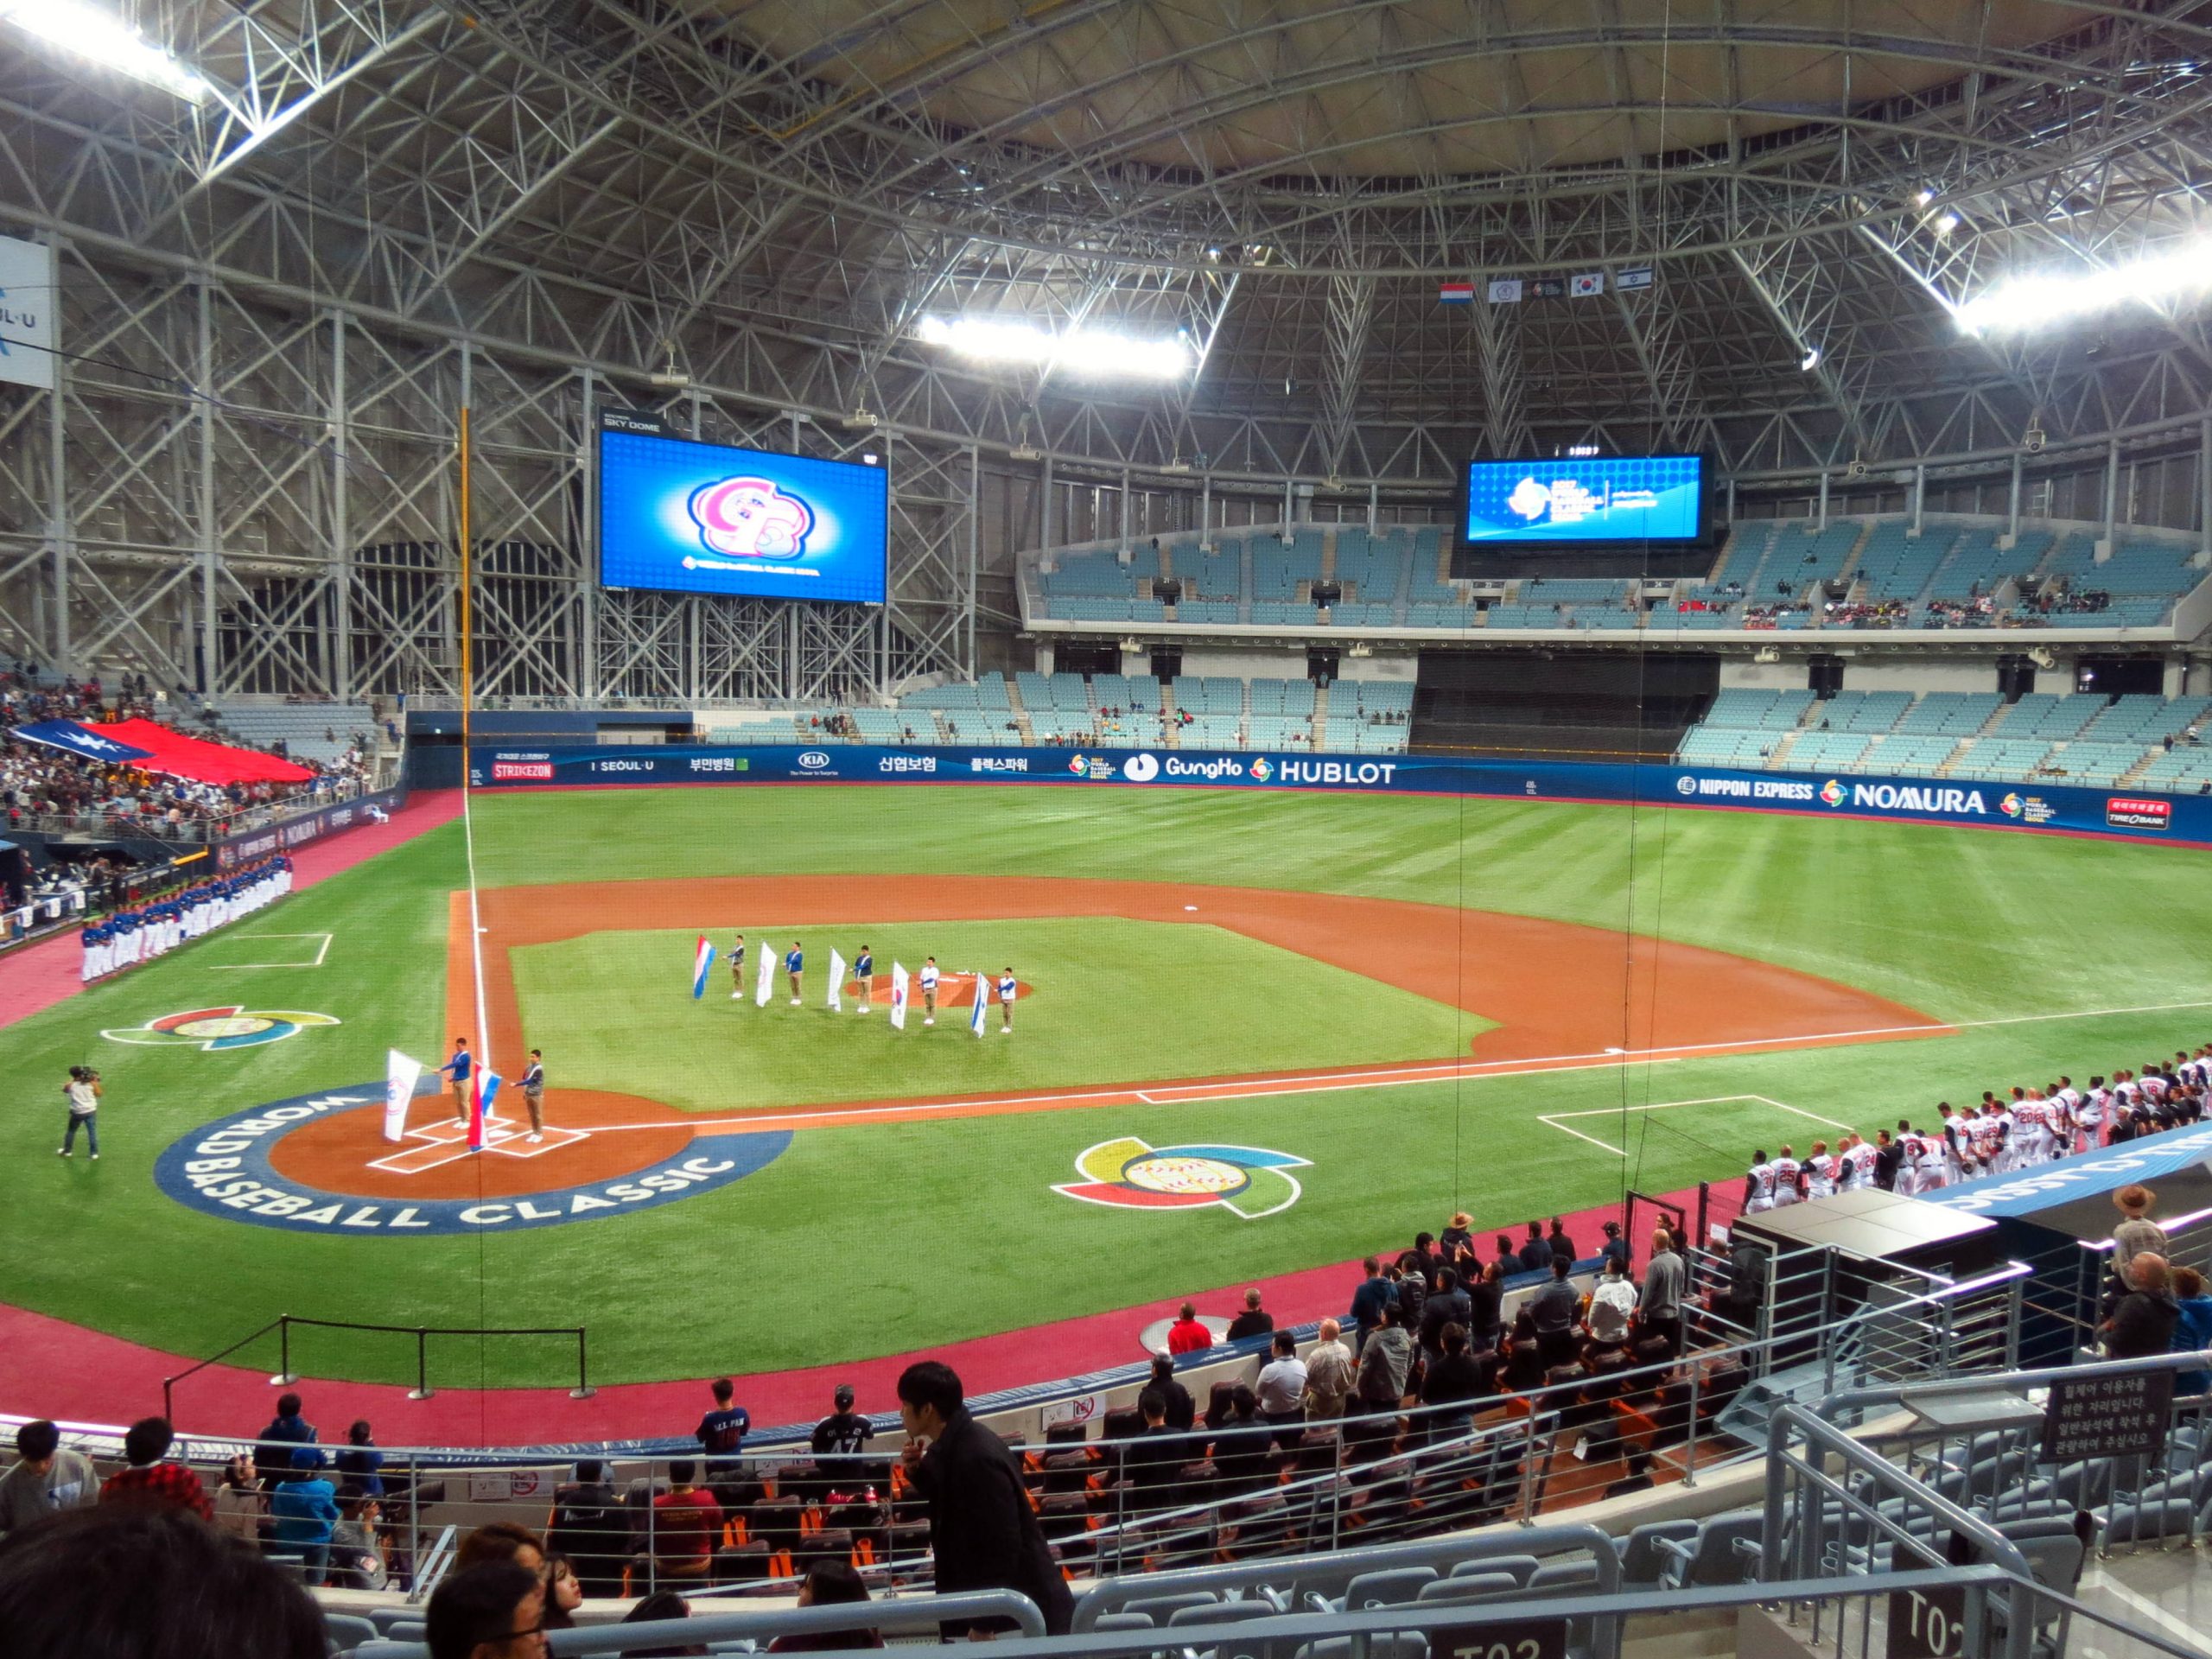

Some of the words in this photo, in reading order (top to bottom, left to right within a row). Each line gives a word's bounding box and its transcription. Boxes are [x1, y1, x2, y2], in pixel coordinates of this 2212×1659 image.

[604, 418, 626, 428] SKY
[629, 422, 660, 432] DOME
[495, 764, 551, 778] STRIKEZON
[690, 758, 735, 772] 부민병원
[879, 757, 936, 772] 신협보험
[971, 757, 1028, 772] 플렉스파워
[1166, 757, 1243, 779] GungHo
[1281, 760, 1396, 784] HUBLOT
[1699, 779, 1751, 797] NIPPON
[1754, 781, 1814, 800] EXPRESS
[1854, 784, 1986, 814] NOMURA
[196, 1096, 370, 1155] WORLD
[2019, 1112, 2032, 1123] 20
[1780, 1169, 1796, 1183] 25
[185, 1156, 430, 1227] BASEBALL
[459, 1157, 734, 1224] CLASSIC
[830, 1437, 859, 1454] 47
